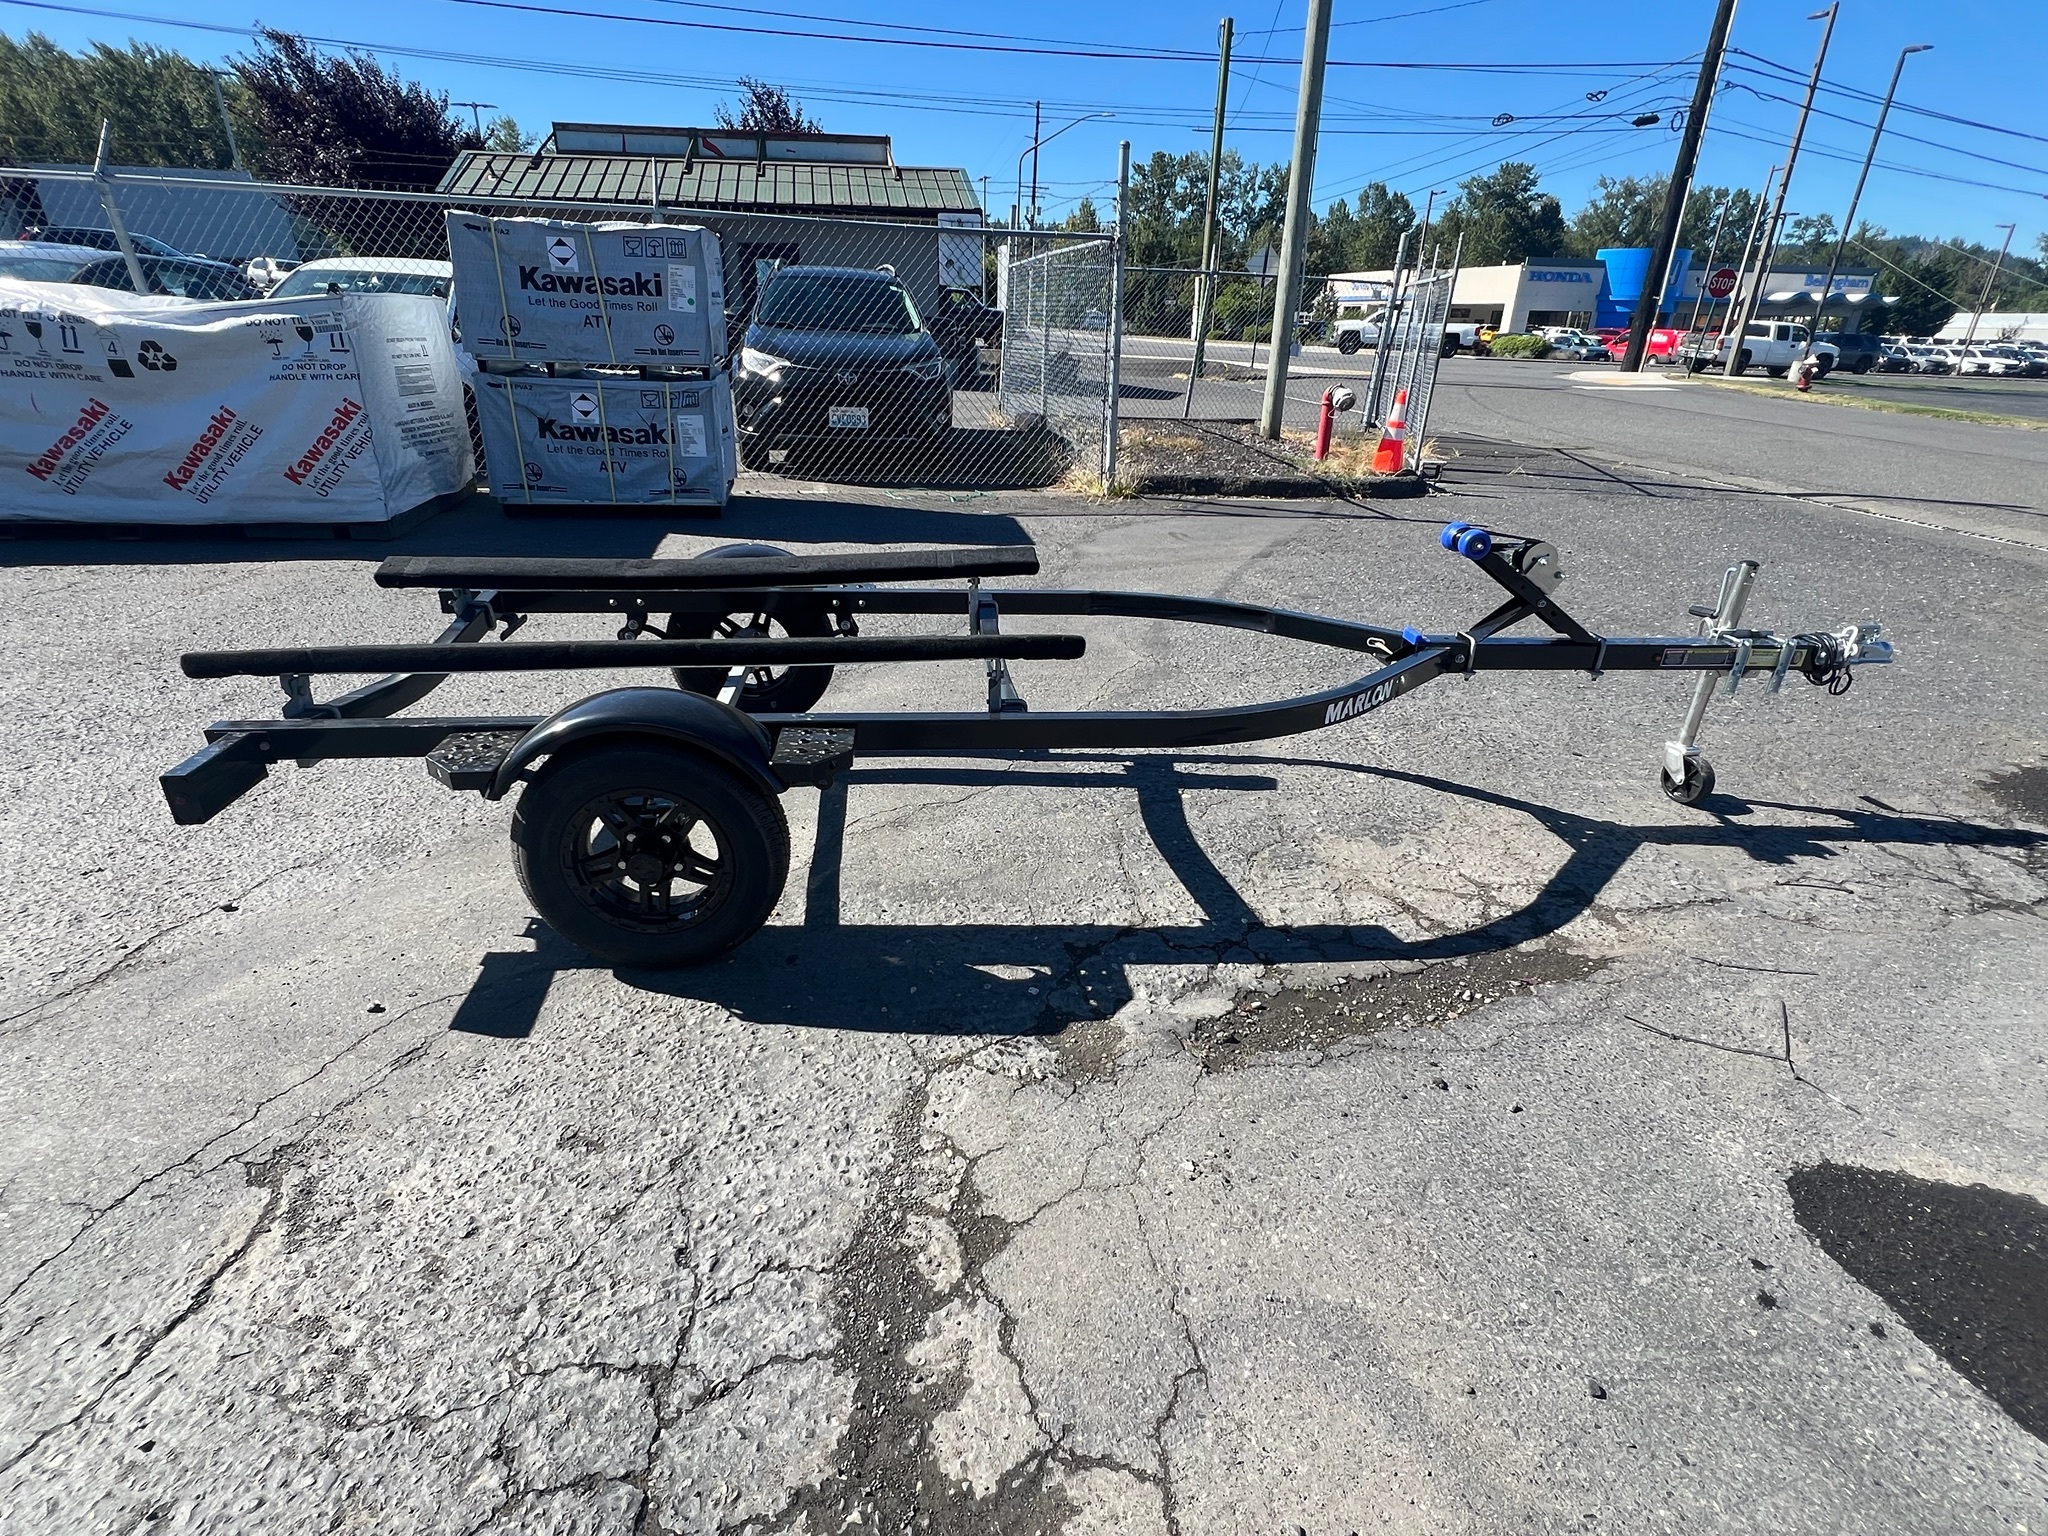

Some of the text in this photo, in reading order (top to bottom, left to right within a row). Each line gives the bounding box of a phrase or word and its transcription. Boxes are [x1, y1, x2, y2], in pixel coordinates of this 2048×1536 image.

[518, 265, 663, 297] Kawasaki
[1528, 271, 1593, 283] HONDA
[1710, 277, 1735, 290] STOP
[528, 296, 545, 307] Let
[549, 297, 566, 308] the
[569, 299, 600, 310] Good
[637, 301, 658, 312] Roll
[0, 309, 18, 319] OT
[22, 312, 43, 322] TILT
[66, 314, 86, 325] END
[265, 318, 288, 327] NOT
[290, 317, 310, 325] TIL
[107, 341, 118, 355] 4
[0, 369, 104, 383] HANDLE WITH CARE
[14, 360, 83, 371] DO NOT DROP
[281, 363, 346, 371] DO NOT DROP
[269, 373, 307, 381] HANDLE
[309, 373, 333, 381] WITH
[26, 397, 110, 481] Kawasaki
[283, 397, 363, 486] Kawasaki
[538, 417, 676, 445] Kawasaki
[52, 472, 68, 486] Let
[61, 462, 74, 475] the
[69, 446, 86, 466] good
[83, 429, 106, 448] times
[62, 419, 133, 496] UTILITY VEHICLE
[163, 405, 237, 491] Kawasaki
[307, 475, 321, 489] Let
[318, 463, 331, 477] the
[328, 446, 344, 466] good
[340, 428, 360, 448] times
[546, 443, 670, 458] Let the Good Times Rol
[187, 482, 201, 496] Let
[198, 470, 211, 484] the
[207, 452, 224, 473] good
[218, 435, 237, 456] times
[196, 424, 264, 505] UTILITY VEHICLE
[599, 461, 627, 474] ATV
[315, 459, 350, 498] UTILITY
[1324, 679, 1394, 725] MARLON
